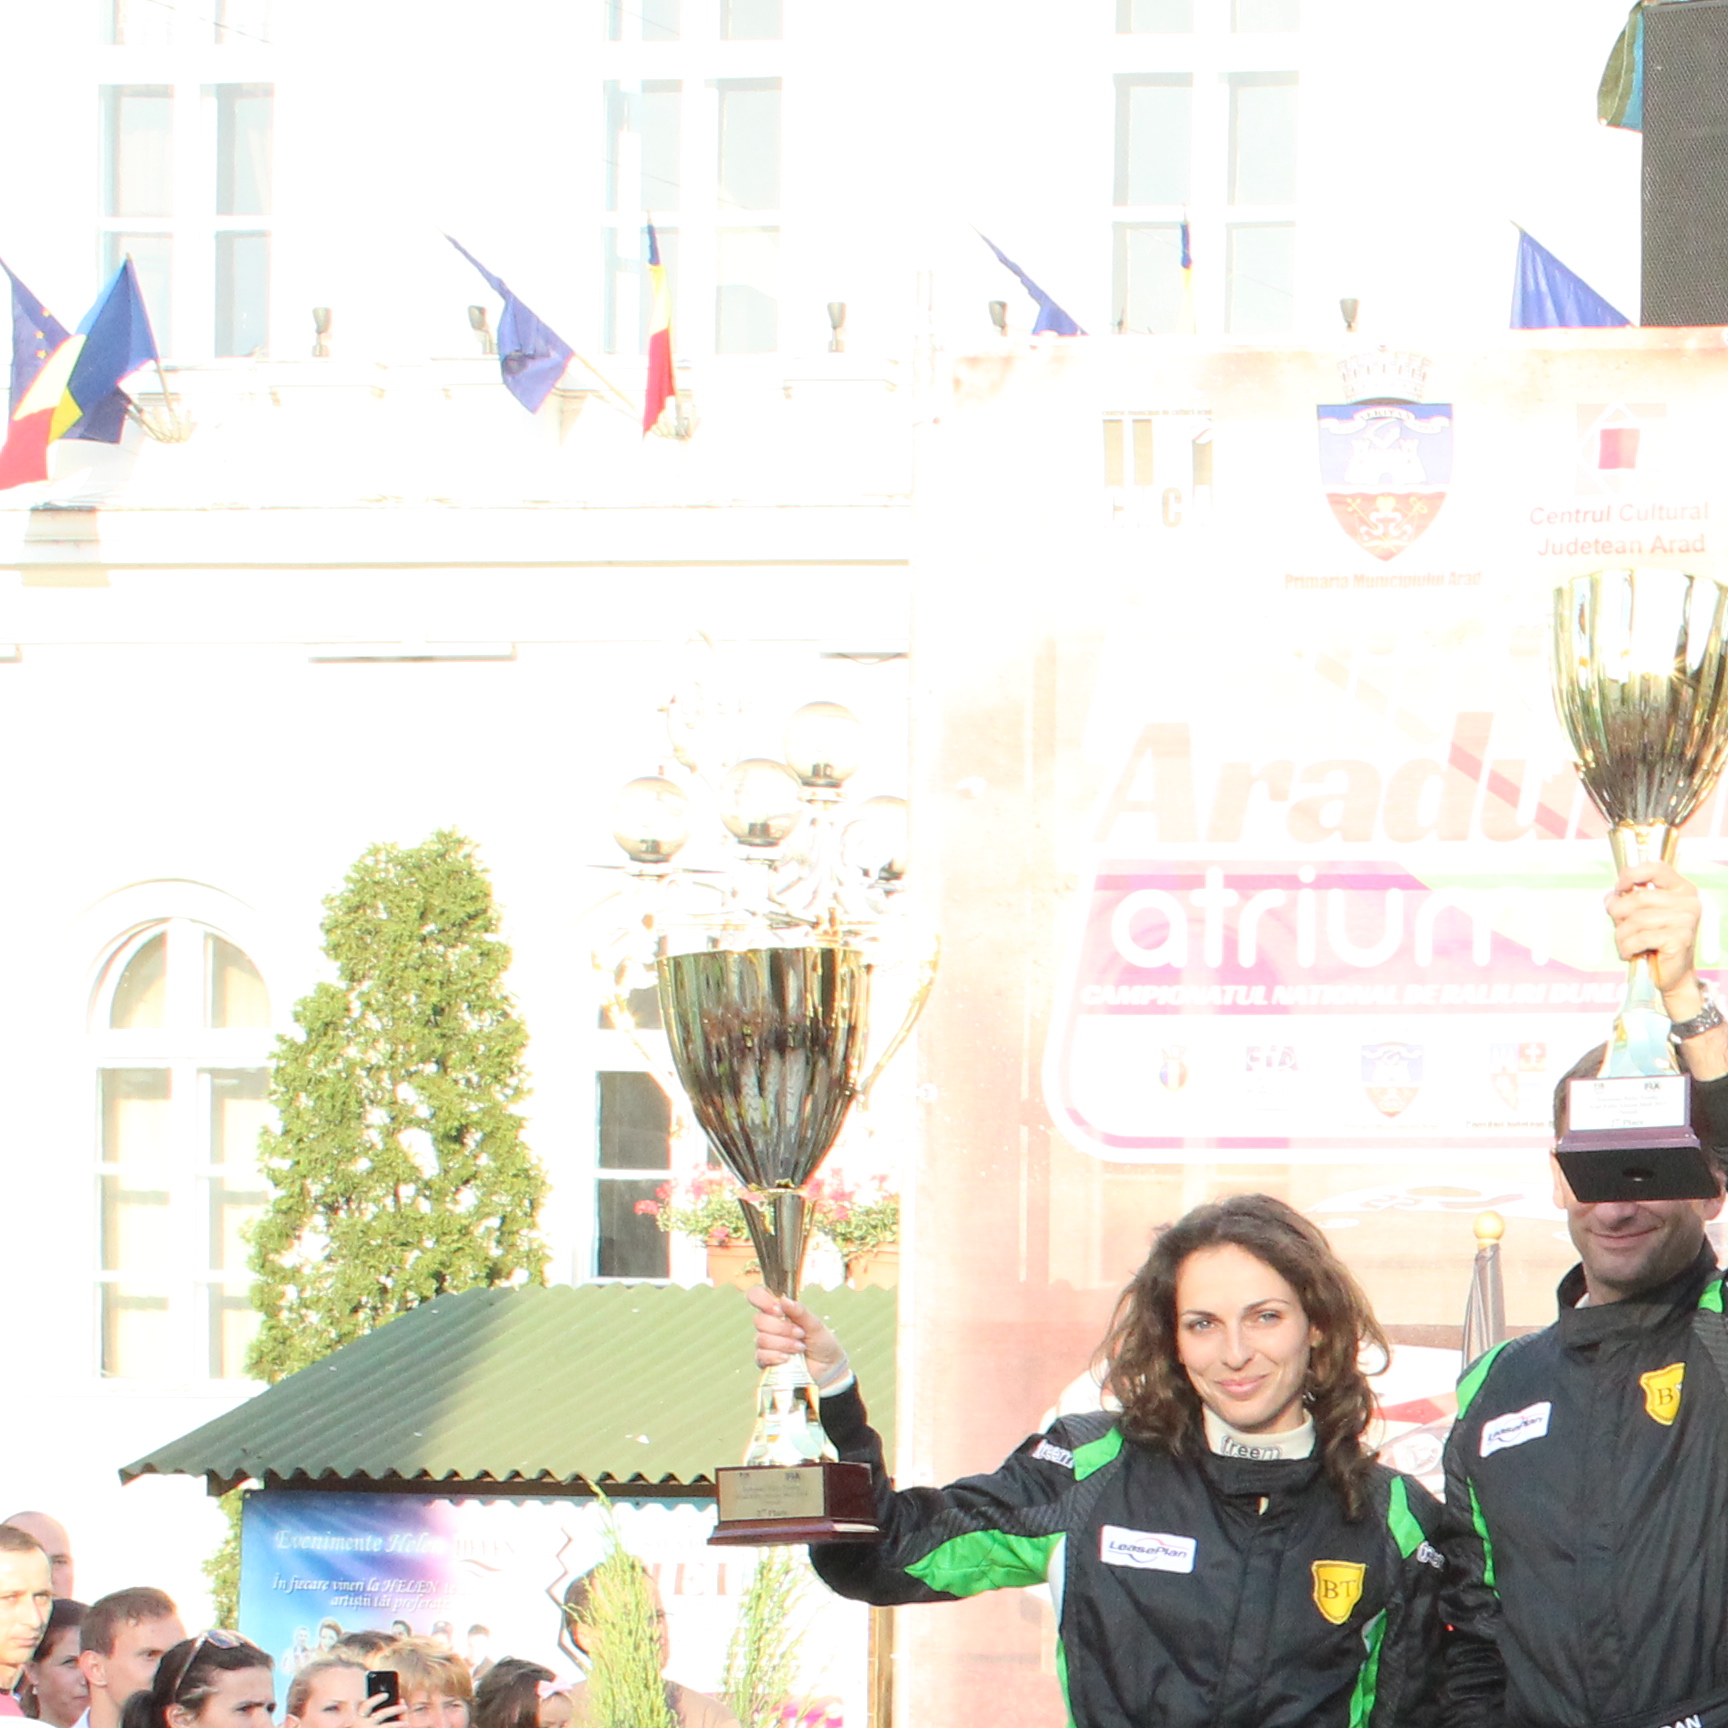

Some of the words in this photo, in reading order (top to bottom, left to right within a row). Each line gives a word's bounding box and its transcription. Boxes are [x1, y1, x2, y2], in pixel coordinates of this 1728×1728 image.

[1529, 503, 1611, 526] Centrul
[1619, 500, 1711, 523] Cultural
[1538, 532, 1641, 558] Judetean
[1649, 530, 1707, 556] Arad
[1110, 865, 1552, 969] atrium
[1108, 1538, 1188, 1560] LeasePlan
[1321, 1576, 1359, 1600] BT
